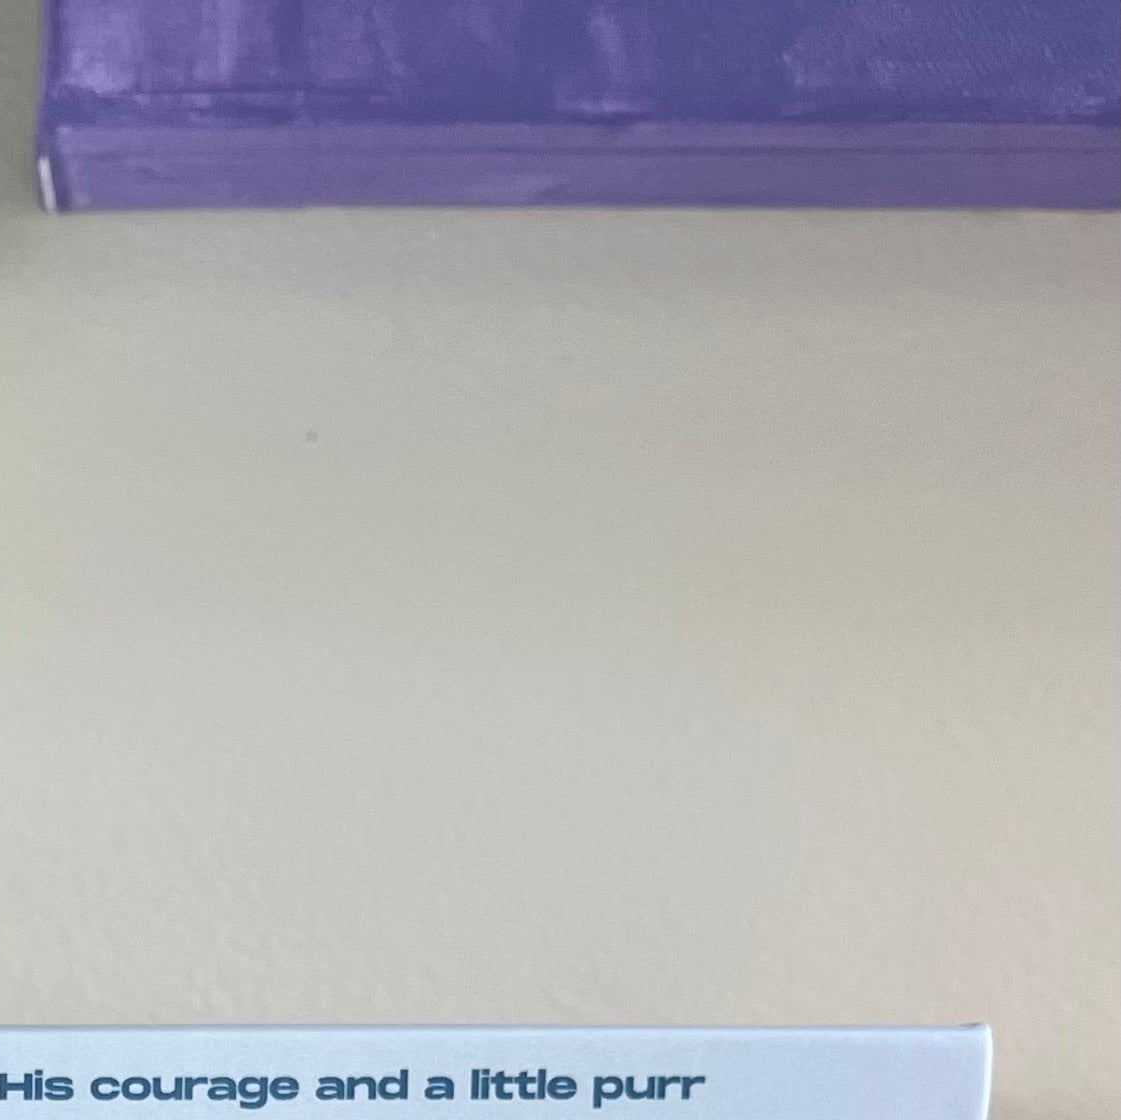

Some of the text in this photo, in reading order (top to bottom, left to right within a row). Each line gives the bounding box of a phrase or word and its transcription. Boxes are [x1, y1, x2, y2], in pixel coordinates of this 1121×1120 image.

[90, 1076, 300, 1110] courage
[315, 1068, 409, 1101] and
[424, 1075, 455, 1101] a
[470, 1068, 578, 1101] little
[592, 1075, 707, 1110] purr
